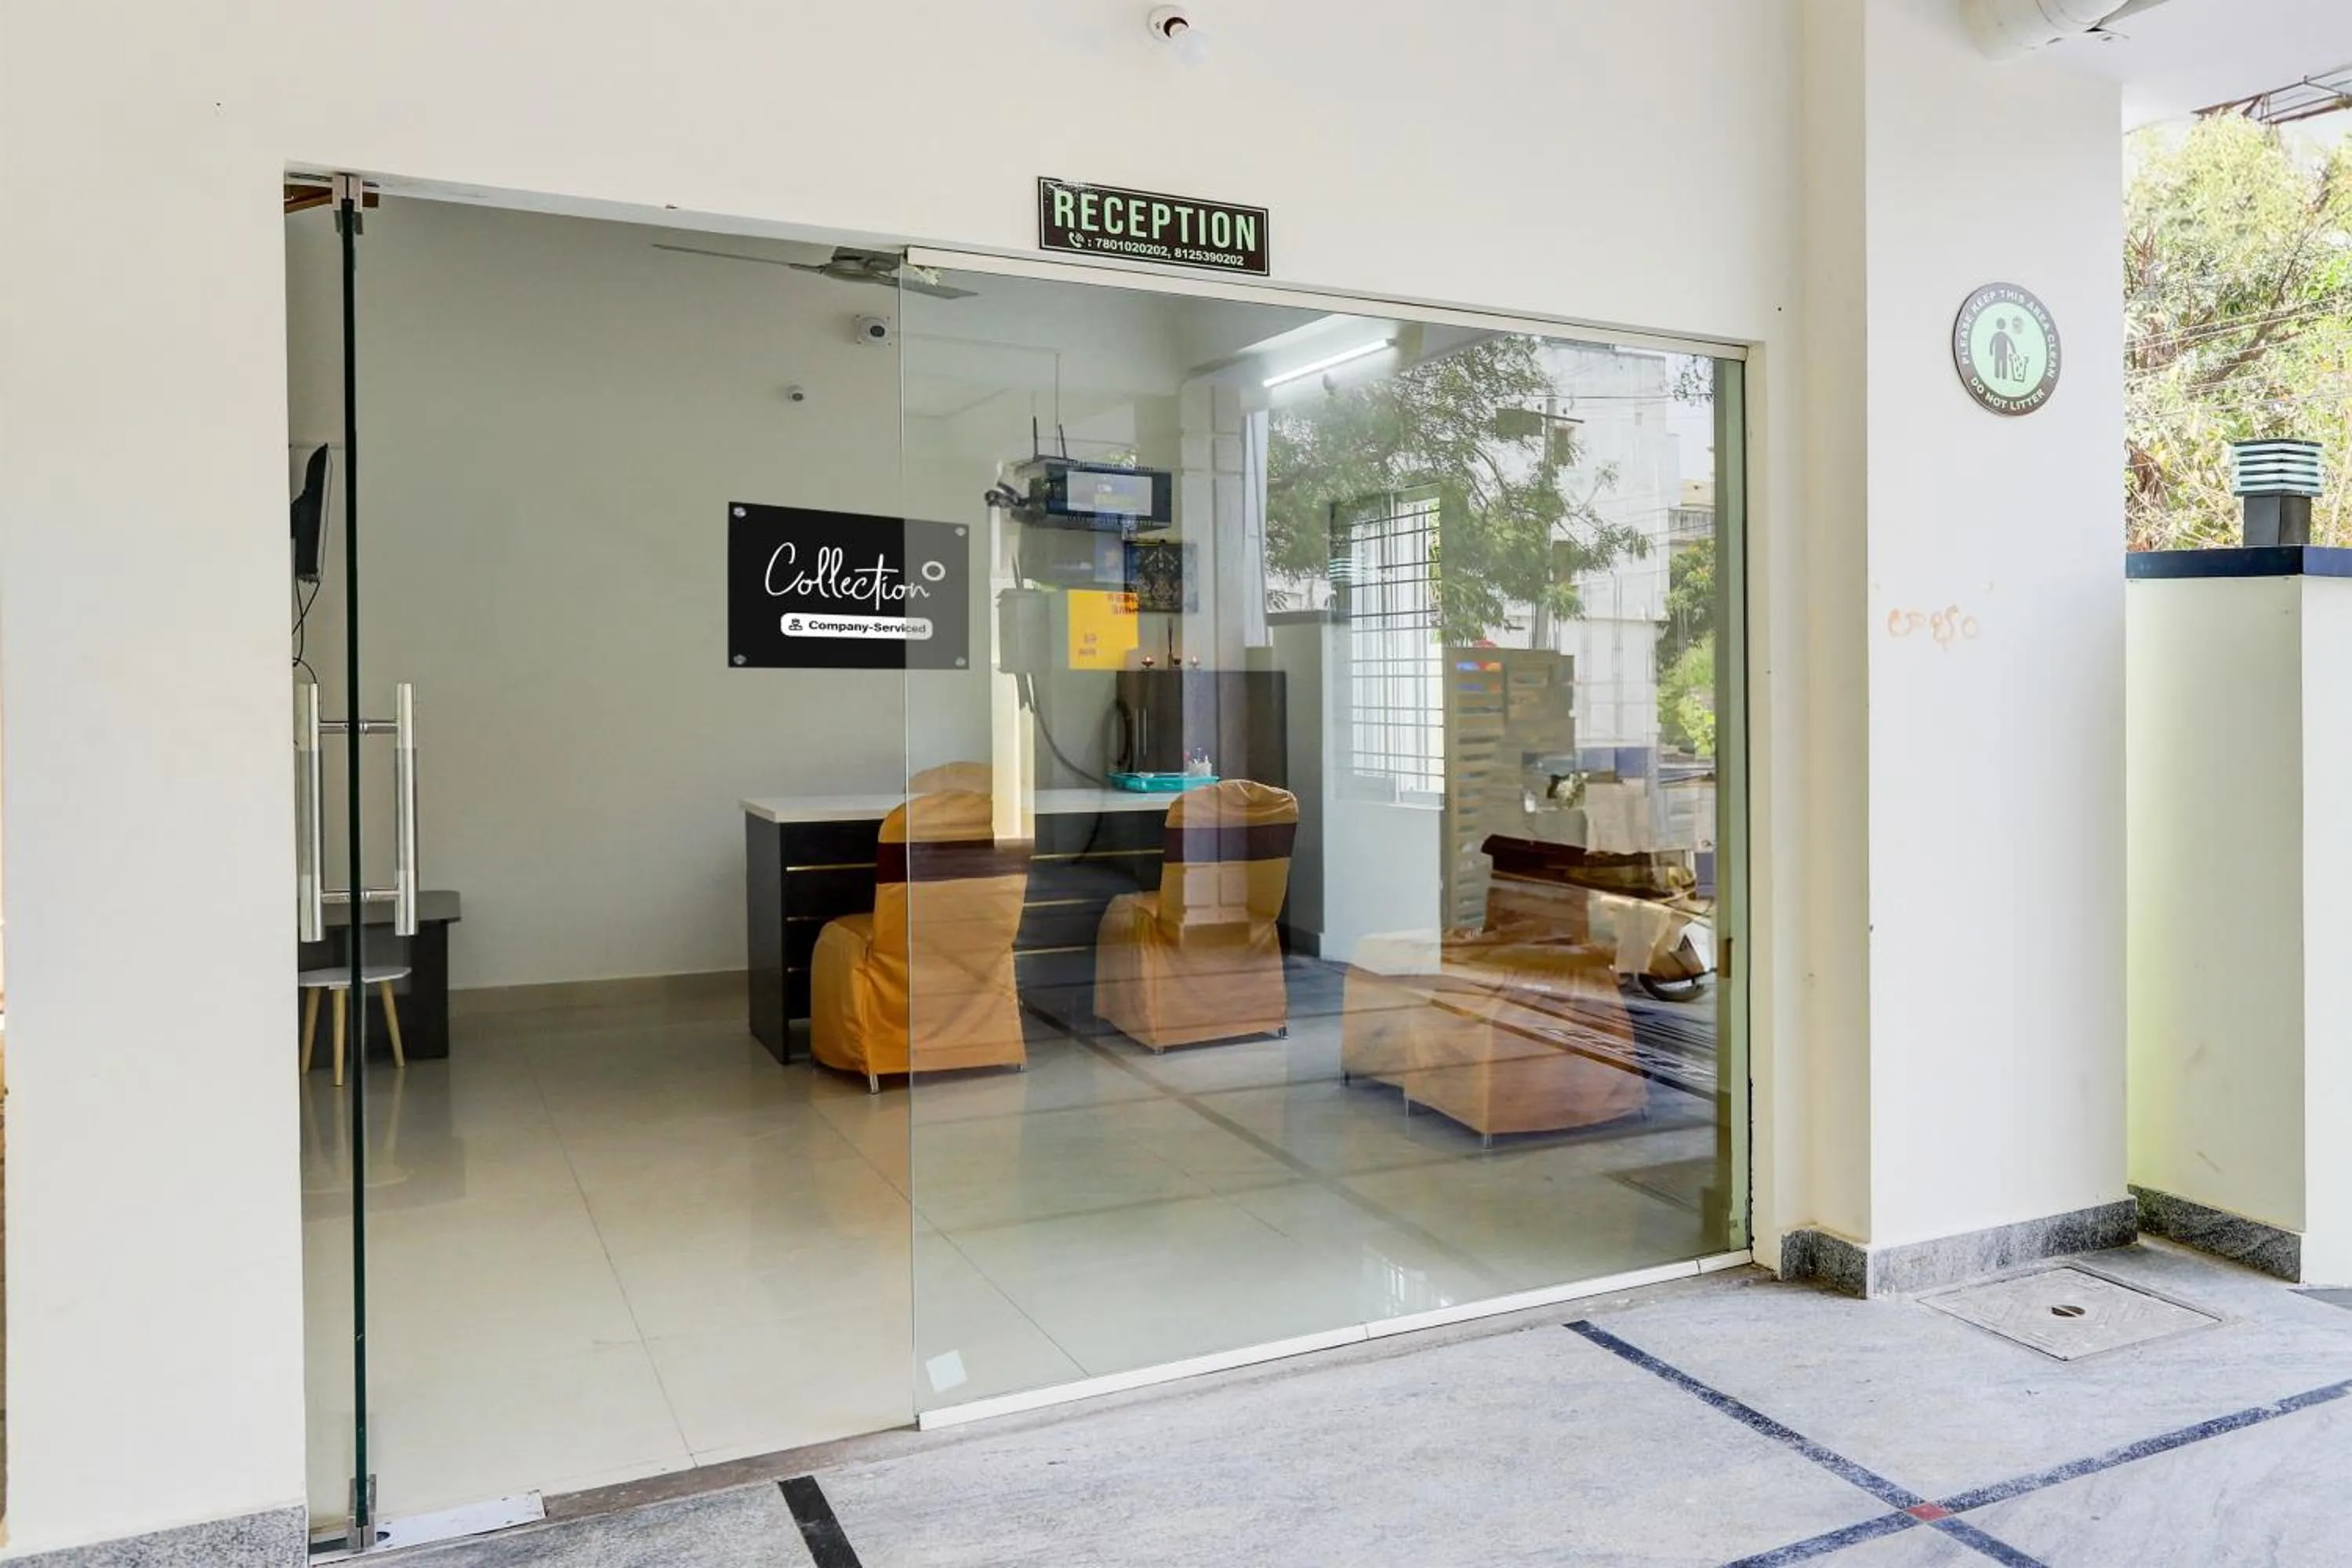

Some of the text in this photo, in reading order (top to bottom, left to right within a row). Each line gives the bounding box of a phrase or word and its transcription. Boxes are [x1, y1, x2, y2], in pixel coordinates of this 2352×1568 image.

[1053, 187, 1256, 252] RECEPTION
[1096, 238, 1171, 260] 7801020202,
[1174, 248, 1245, 266] 8125390202
[1960, 289, 2058, 379] PLEASE KEEP THIS AREA CLEAN
[1970, 377, 2045, 411] DO NOT LITTER
[764, 542, 931, 611] Collection
[808, 619, 927, 635] Company-Serviced
